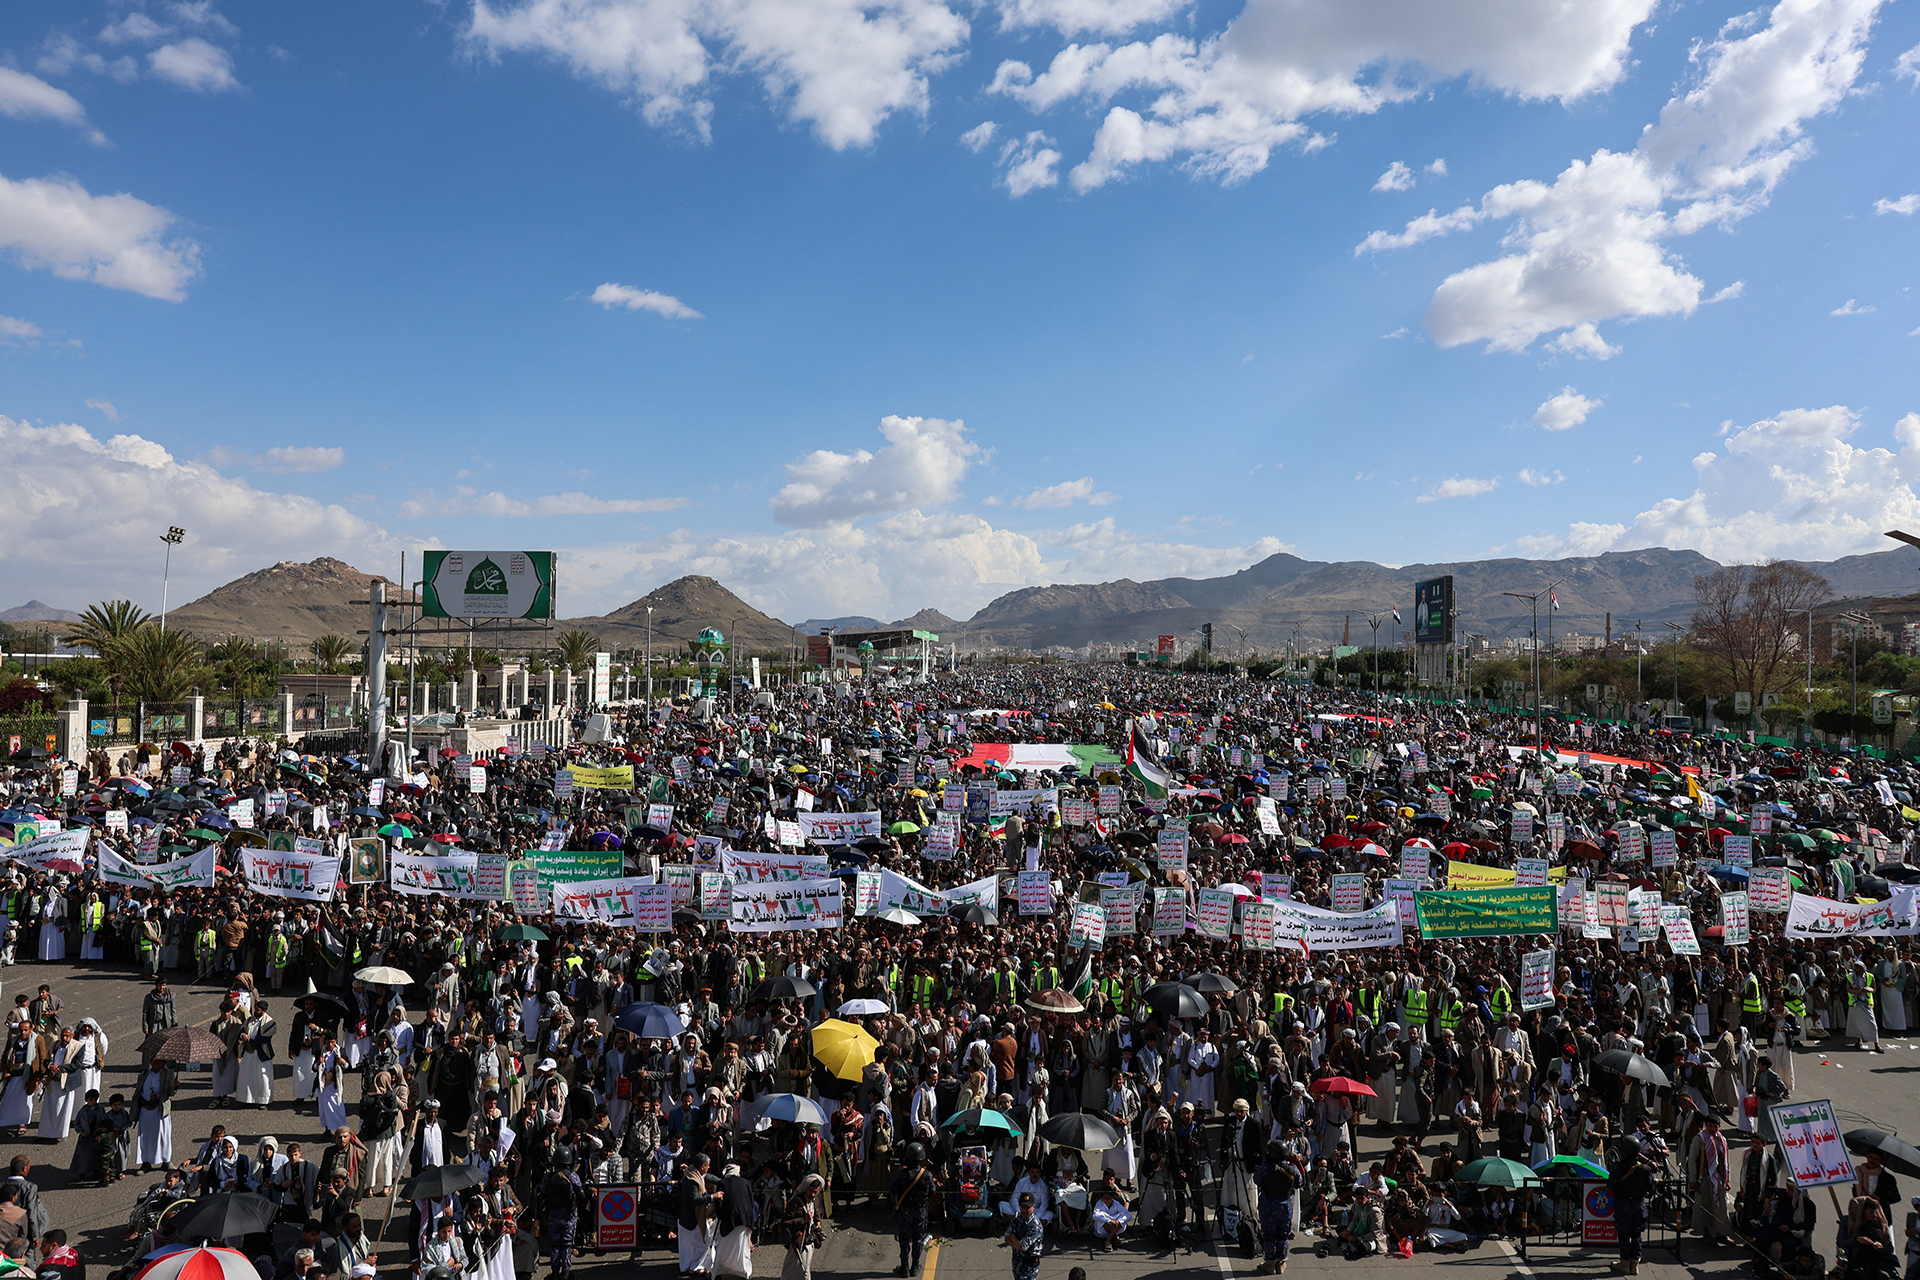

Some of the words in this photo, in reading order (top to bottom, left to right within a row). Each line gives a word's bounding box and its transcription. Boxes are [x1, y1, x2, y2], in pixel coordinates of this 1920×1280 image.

[1022, 874, 1036, 883] أكبر
[639, 888, 654, 897] أكبر
[776, 889, 801, 901] واحدة
[804, 888, 839, 898] ساحاتنا
[1530, 891, 1550, 901] ثبات
[1419, 896, 1438, 905] إيران
[1440, 896, 1451, 906] في
[1453, 895, 1487, 905] الإسلامية
[1489, 893, 1528, 904] الجمهورية
[1422, 908, 1447, 919] القيادة
[1449, 909, 1475, 917] مستوى
[1478, 908, 1493, 917] على
[1538, 905, 1551, 915] كان
[1423, 922, 1456, 932] تشكيلاتها
[1457, 921, 1470, 931] بكل
[1471, 920, 1498, 929] المسلحة
[1499, 919, 1524, 929] والقوات
[1524, 919, 1551, 928] والشعب
[1777, 1104, 1829, 1129] قاطعوا
[1782, 1129, 1813, 1149] الأمريكية
[1814, 1127, 1838, 1146] البضائع
[1813, 1148, 1818, 1160] و
[1796, 1162, 1851, 1183] الإسرائيلية
